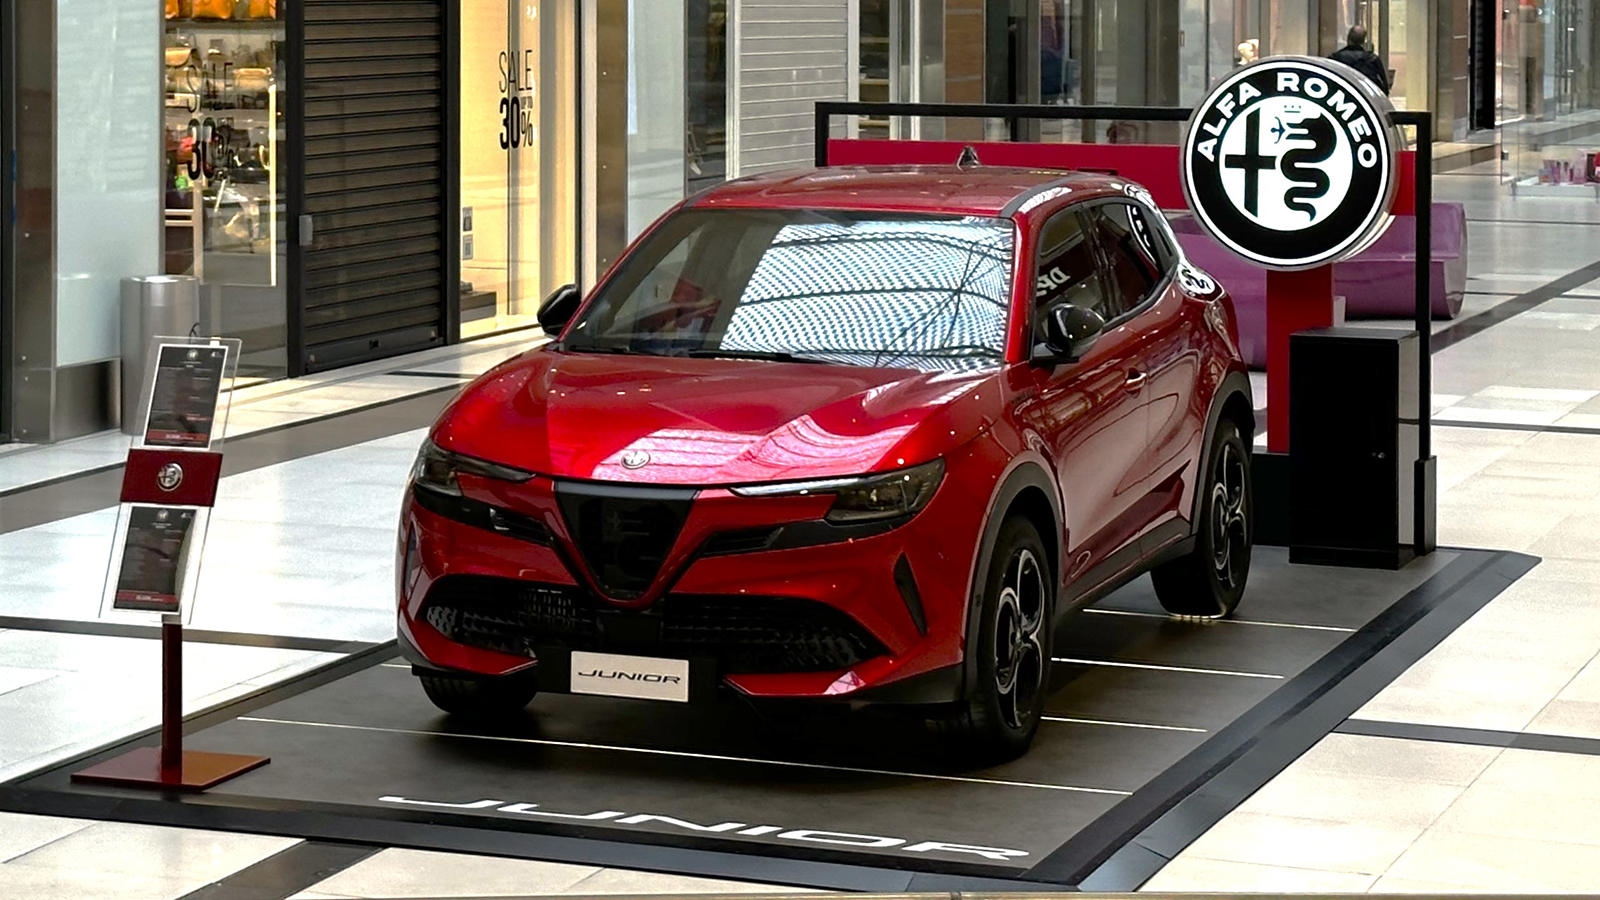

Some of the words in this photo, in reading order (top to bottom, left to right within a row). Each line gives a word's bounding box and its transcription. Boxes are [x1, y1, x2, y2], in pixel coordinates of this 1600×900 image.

[498, 49, 533, 93] SALE
[499, 96, 533, 151] 30%
[1197, 82, 1262, 162] ALFA
[1277, 72, 1378, 169] ROMEO
[577, 669, 681, 685] JUNIOR
[378, 795, 1029, 861] JUNIOR
